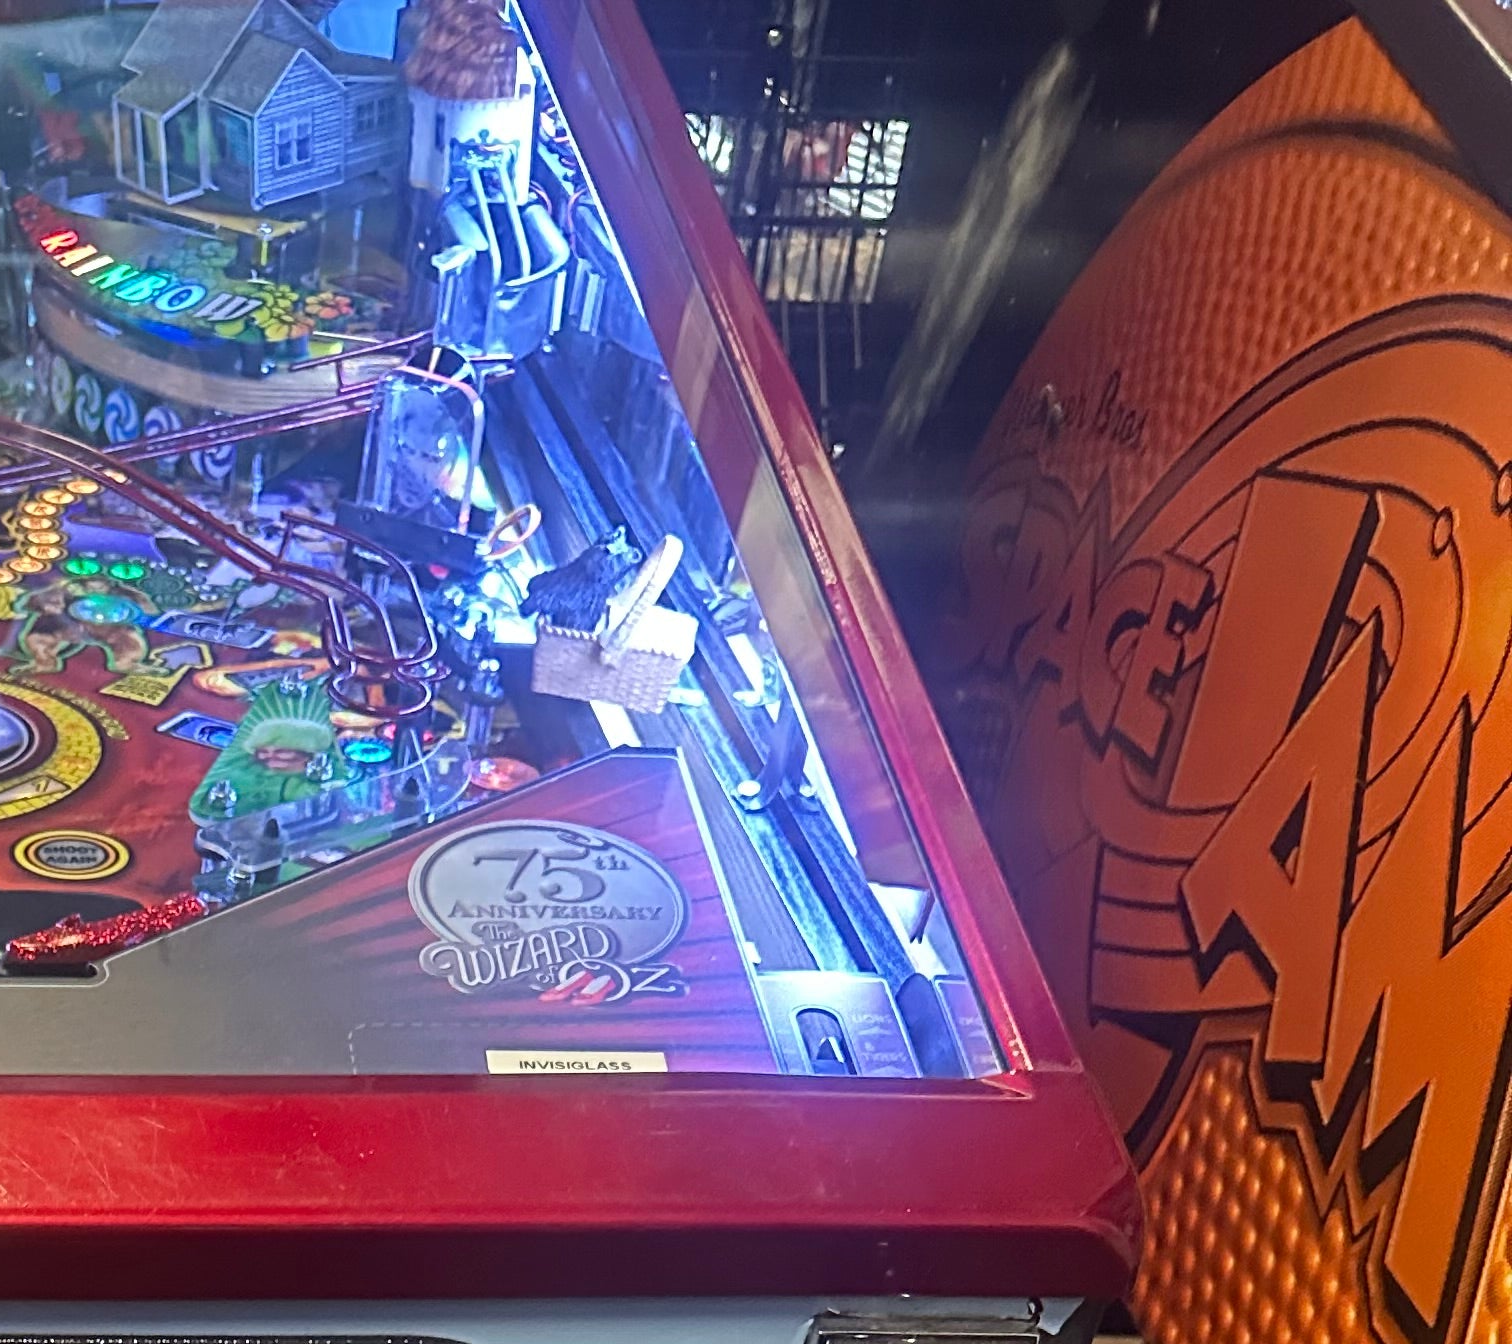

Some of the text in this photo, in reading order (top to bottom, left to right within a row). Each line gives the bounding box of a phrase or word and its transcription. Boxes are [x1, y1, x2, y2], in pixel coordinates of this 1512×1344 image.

[40, 230, 263, 321] RAINBOW
[447, 901, 664, 921] ANNIVERSARY
[429, 924, 611, 987] WIZARD
[519, 1060, 632, 1072] INVISIGLASS
